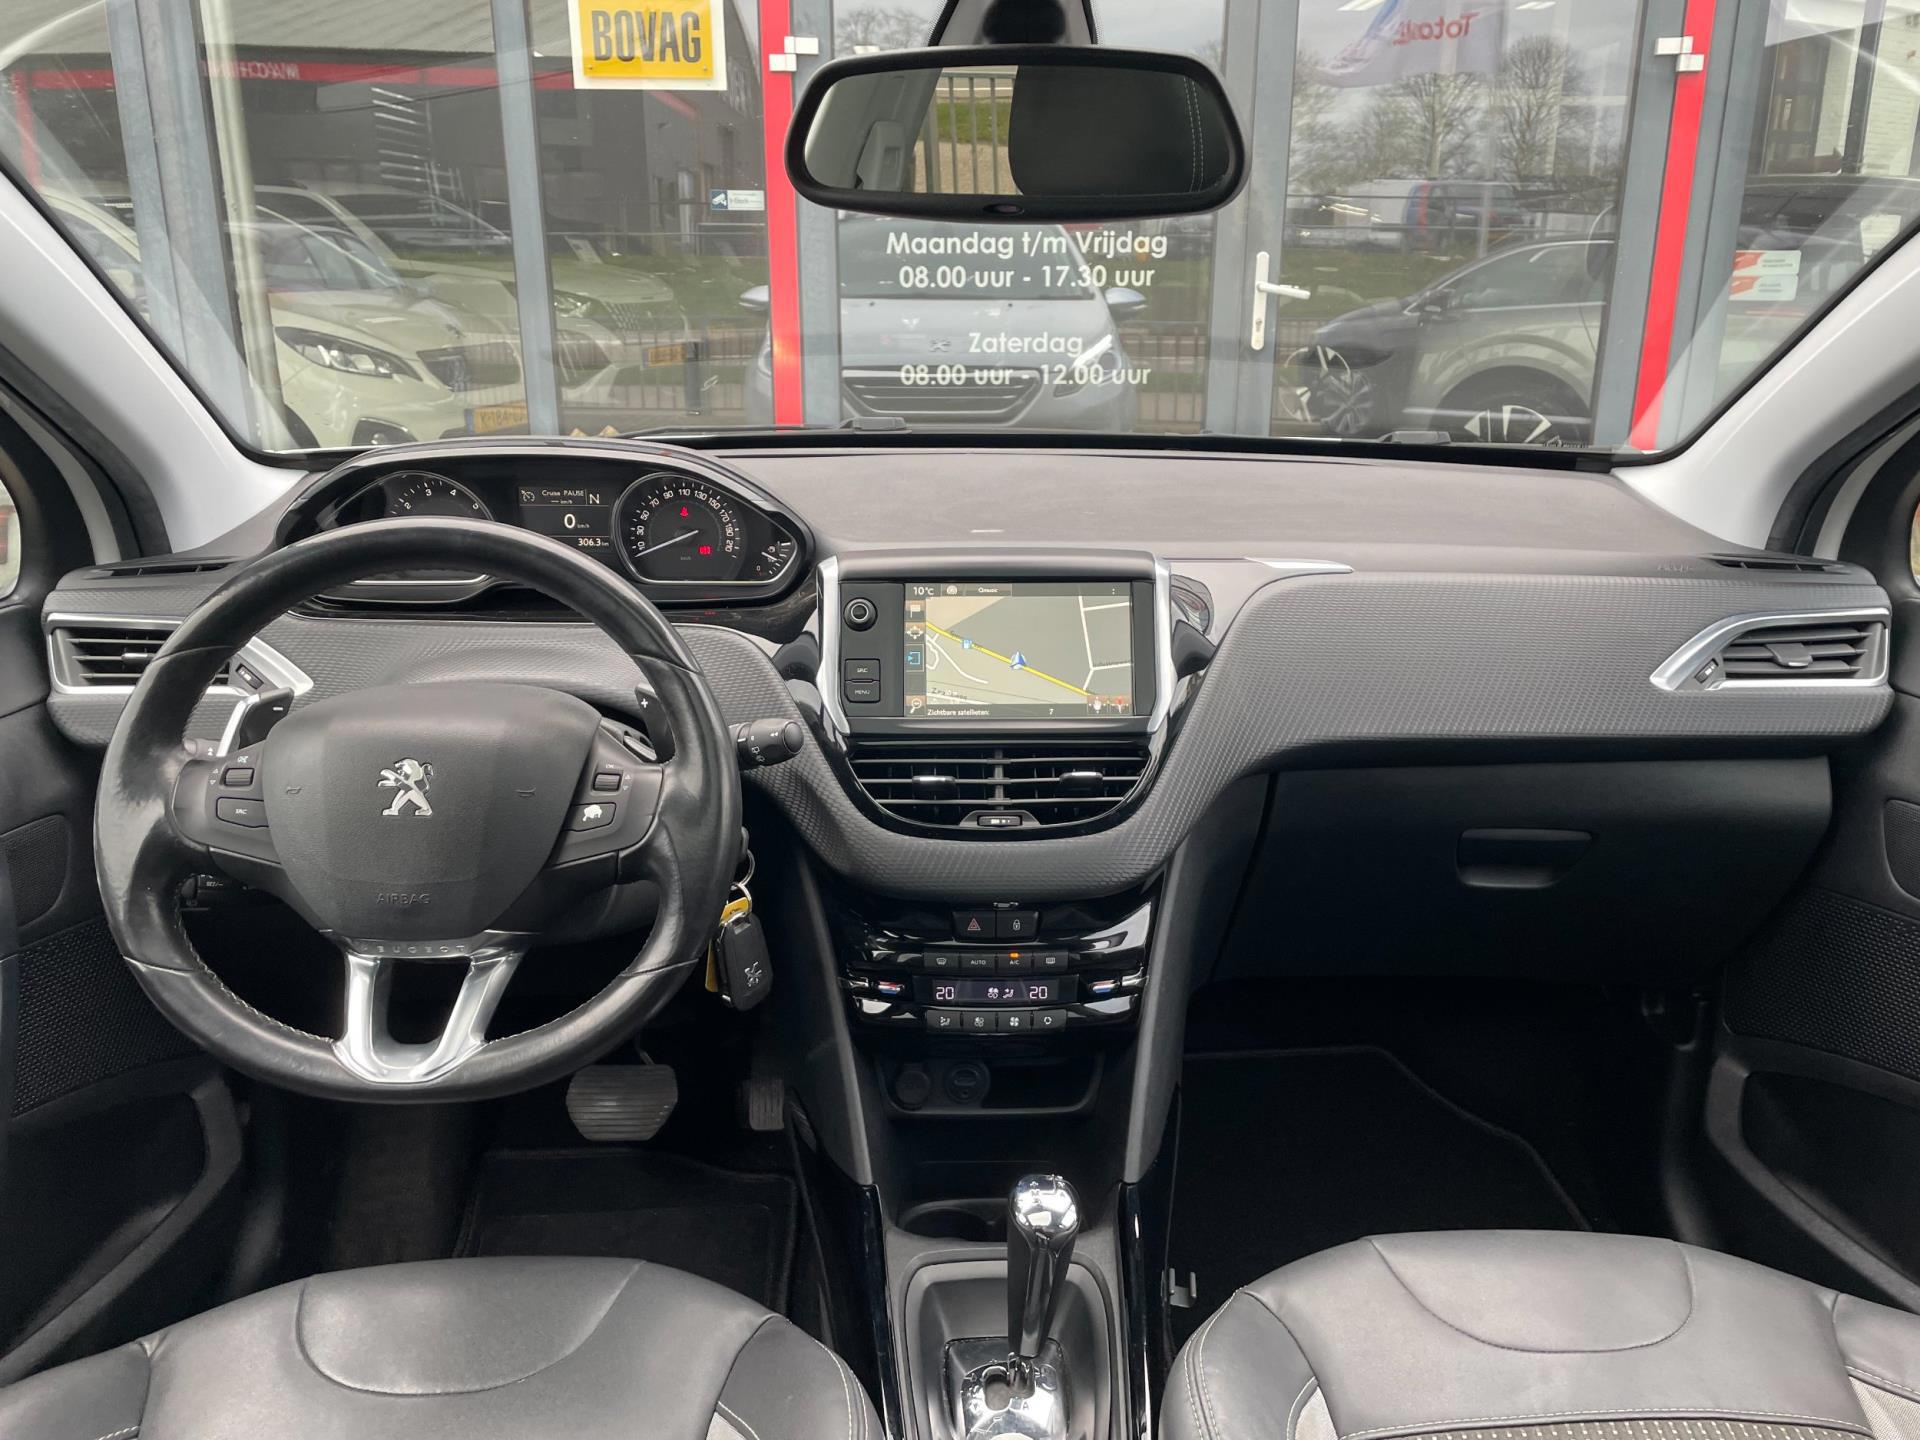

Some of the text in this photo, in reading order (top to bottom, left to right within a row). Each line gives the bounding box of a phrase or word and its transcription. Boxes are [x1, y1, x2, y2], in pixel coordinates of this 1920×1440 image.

[592, 10, 702, 63] BOVAG
[886, 231, 1168, 259] Maandag t/m Vrijdag
[899, 265, 967, 288] 08.00
[974, 269, 1015, 287] uur
[1041, 265, 1107, 287] 17.30
[1114, 268, 1155, 287] uur
[968, 332, 1083, 358] Zaterdag
[900, 364, 967, 386] 08.00
[974, 369, 1014, 386] uur
[1040, 363, 1103, 386] 12.00
[1111, 367, 1152, 386] uur
[425, 489, 433, 497] 3
[449, 489, 457, 497] 4
[563, 489, 585, 497] PAUSE
[662, 490, 674, 500] 90
[678, 488, 691, 496] 110
[694, 490, 708, 501] 130
[589, 493, 600, 504] N
[649, 498, 660, 508] 70
[707, 498, 721, 510] 150
[564, 513, 576, 529] 0
[640, 510, 650, 521] 50
[719, 509, 730, 523] 170
[636, 525, 645, 536] 30
[725, 523, 735, 537] 190
[577, 538, 601, 547] 306.3
[637, 541, 646, 551] 10
[724, 539, 734, 553] 210
[912, 586, 935, 596] 10°C
[377, 893, 431, 905] AIRBAG
[935, 986, 955, 1000] 20
[1029, 985, 1048, 999] 20
